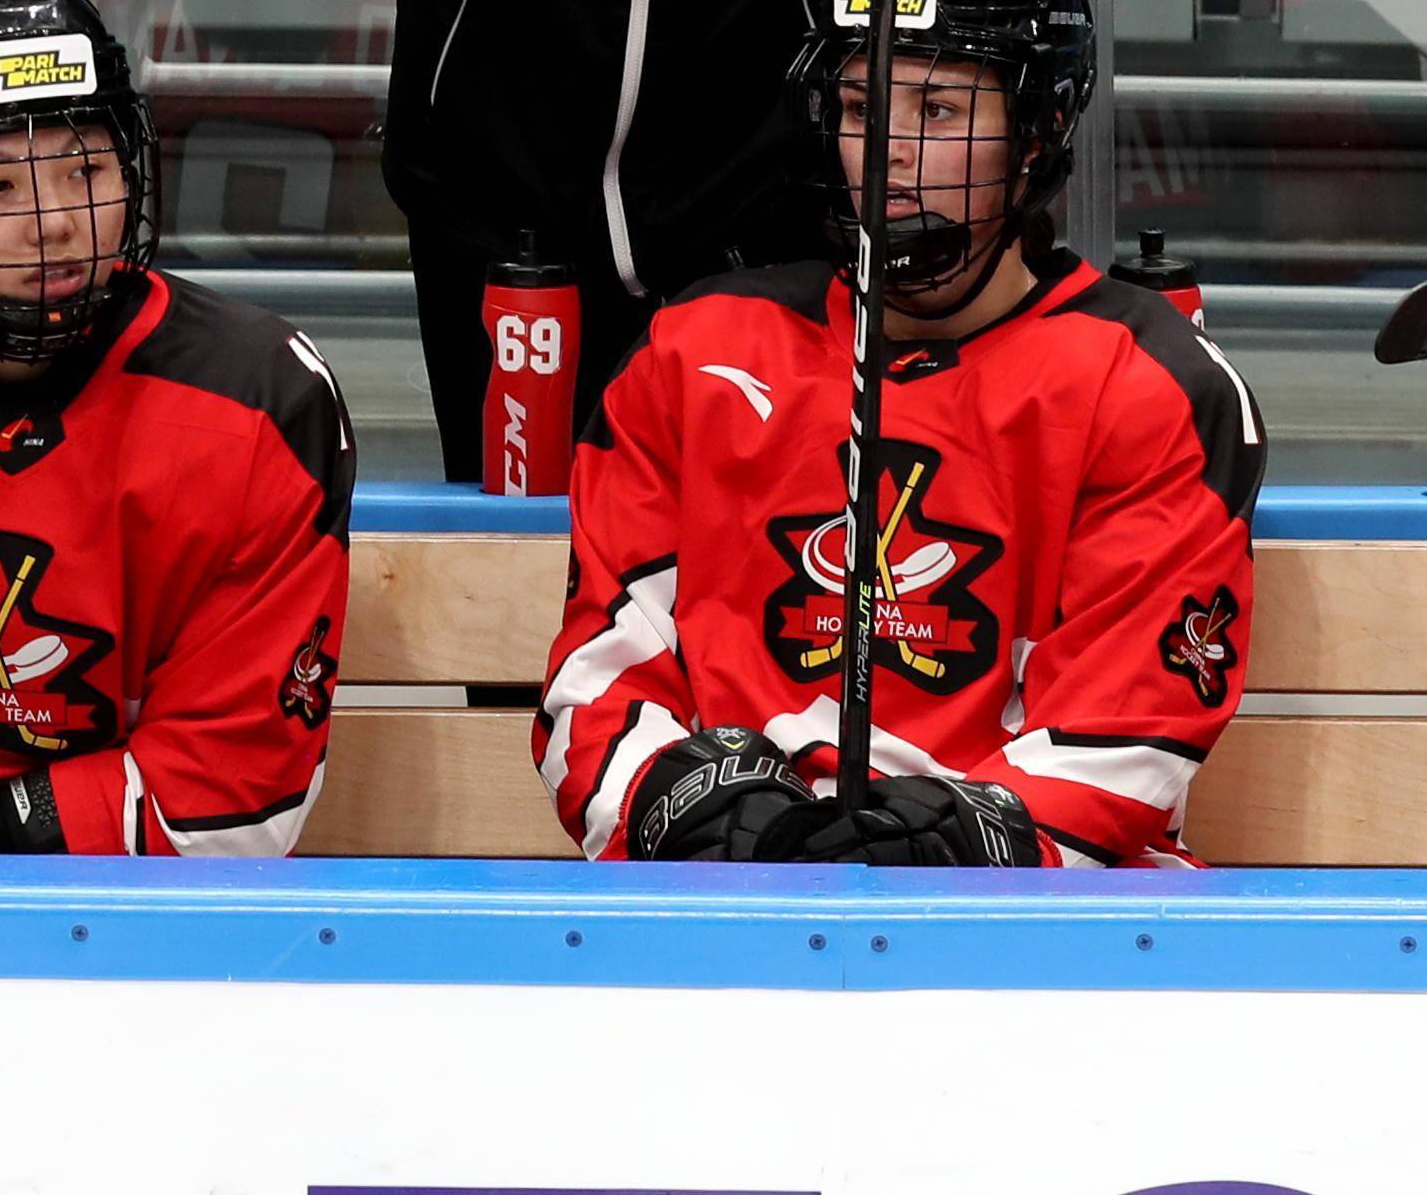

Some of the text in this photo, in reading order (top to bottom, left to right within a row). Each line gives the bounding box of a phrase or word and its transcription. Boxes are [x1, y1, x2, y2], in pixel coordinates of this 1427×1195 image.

[9, 54, 56, 71] PARI
[20, 66, 84, 86] MATCH
[497, 315, 562, 374] 69
[504, 392, 527, 497] CM
[855, 580, 874, 702] HYPERLITE
[887, 620, 933, 639] TEAM
[5, 707, 52, 723] TEAM
[639, 756, 817, 862] BAUE
